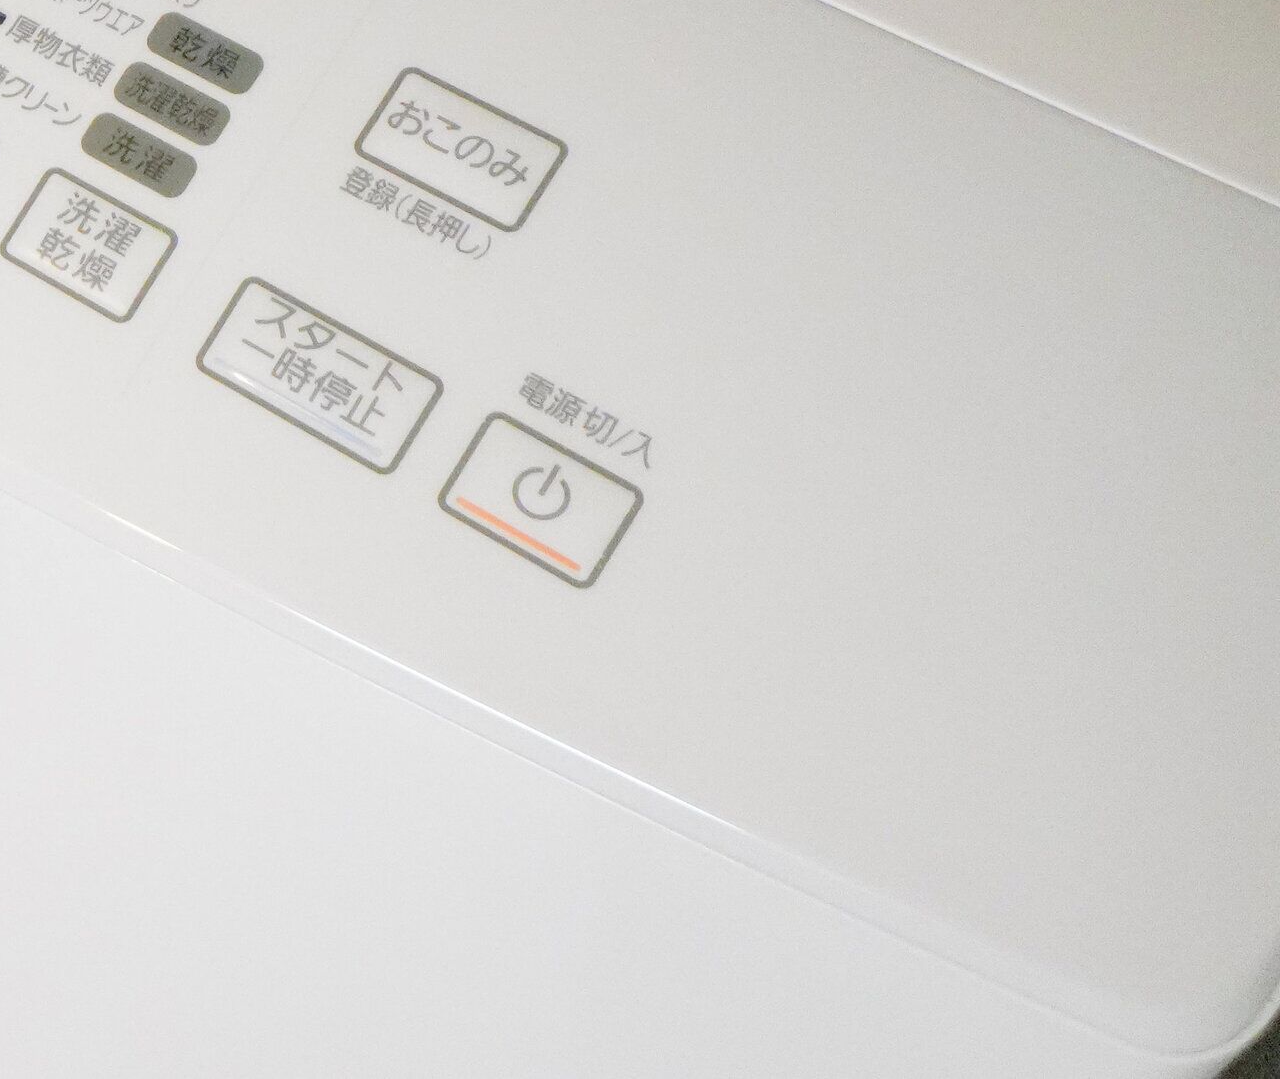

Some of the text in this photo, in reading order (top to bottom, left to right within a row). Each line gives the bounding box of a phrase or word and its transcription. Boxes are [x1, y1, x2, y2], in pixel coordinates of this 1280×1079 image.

[5, 14, 116, 88] 厚物衣類
[168, 27, 241, 80] 乾燥
[124, 73, 222, 137] 洗濯乾燥
[102, 127, 176, 182] 洗濯
[387, 99, 529, 188] おこのみ
[55, 191, 143, 258] 洗濯
[36, 227, 119, 294] 乾燥
[253, 294, 404, 395] スタート
[241, 336, 388, 437] 一時停止
